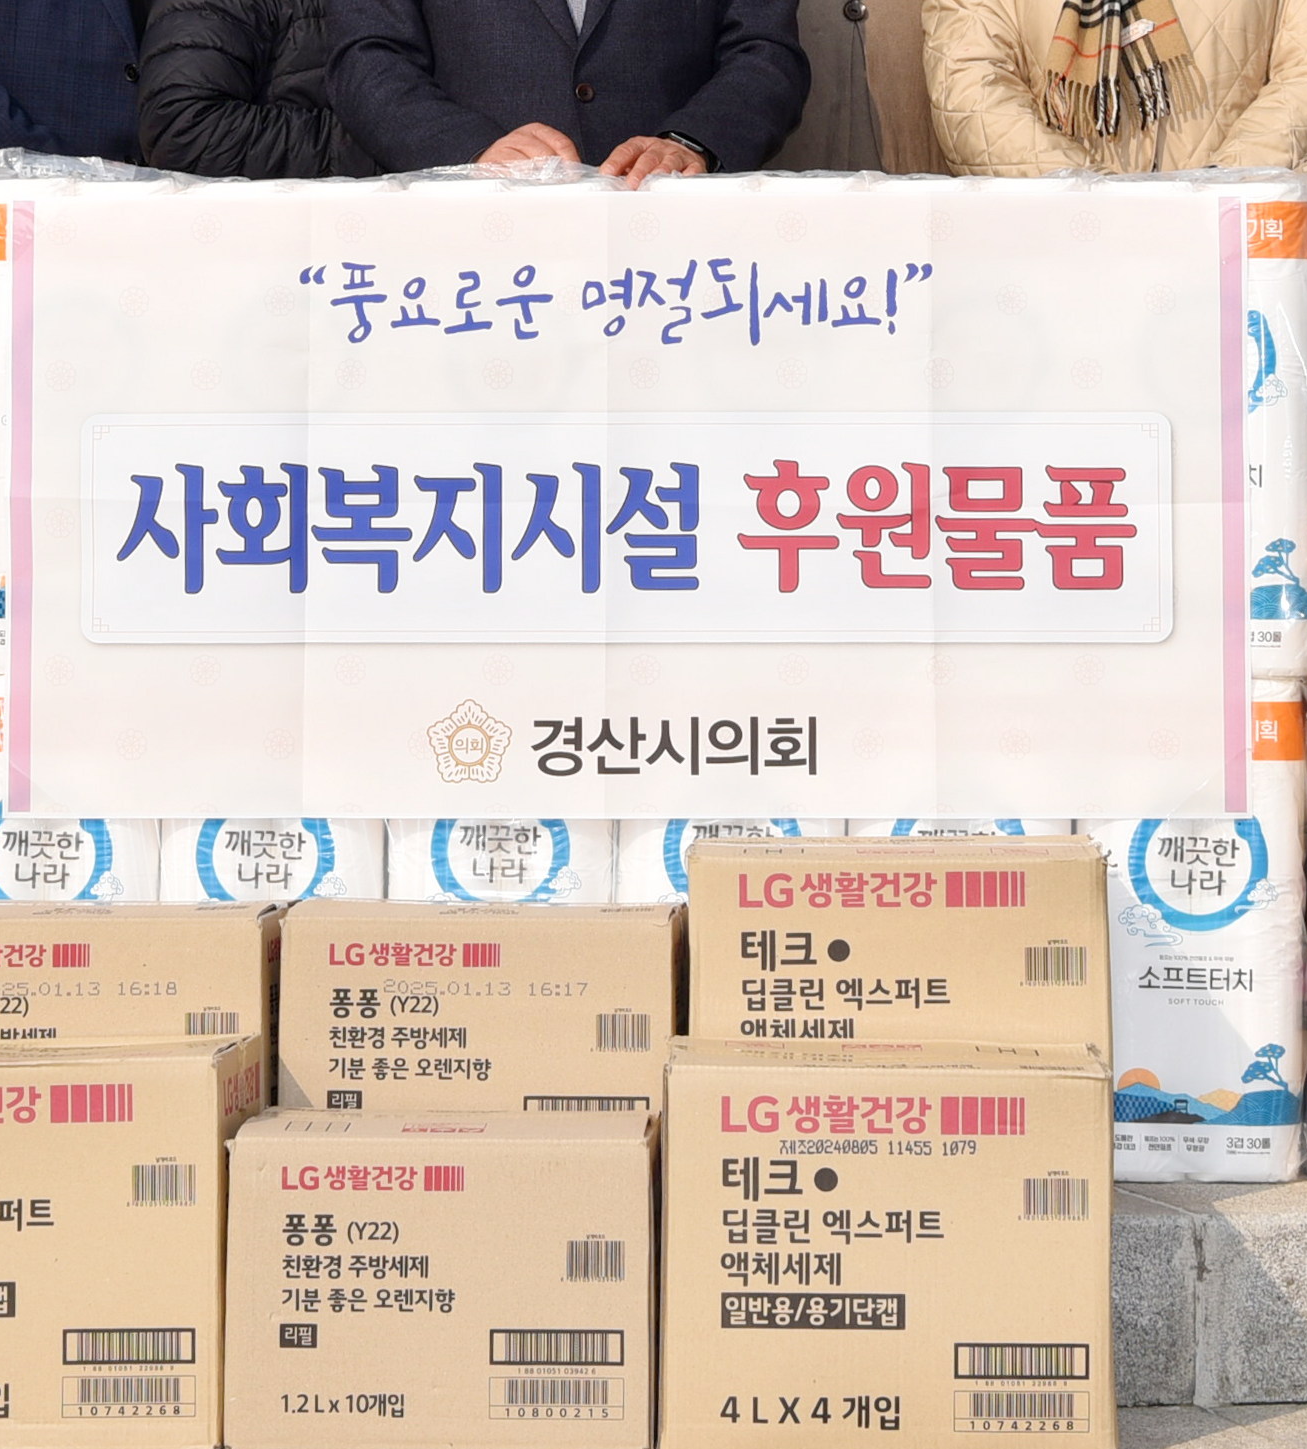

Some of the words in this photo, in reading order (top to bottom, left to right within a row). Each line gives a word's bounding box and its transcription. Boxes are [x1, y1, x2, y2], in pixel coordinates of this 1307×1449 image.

[116, 460, 701, 595] 사회복지시설
[736, 458, 1138, 595] 후원물품
[455, 737, 484, 753] 의회
[530, 716, 818, 777] 경산시의회
[2, 830, 83, 861] 깨끗한
[225, 829, 306, 861] 깨끗한
[1157, 836, 1240, 867] 깨끗한
[15, 863, 69, 890] 나라
[237, 862, 292, 890] 나라
[738, 873, 794, 908] LG
[800, 871, 937, 908] 생활건강
[1171, 870, 1226, 896] 나라
[329, 944, 364, 966] LG
[369, 942, 456, 967] 생활건강
[740, 931, 817, 971] 테크
[118, 981, 178, 996] 16:18
[384, 979, 511, 996] 2025.01.13
[528, 982, 587, 996] 16:17
[1138, 966, 1253, 992] 소프트터치
[329, 988, 381, 1018] 퐁퐁
[390, 995, 439, 1016] (Y22)
[741, 979, 825, 1011] 딥클린
[835, 978, 951, 1010] 엑스퍼트
[329, 1027, 386, 1049] 친환경
[391, 1027, 466, 1049] 주방세제
[329, 1058, 366, 1079] 기분
[371, 1059, 409, 1079] 좋은
[415, 1058, 491, 1080] 오렌지향
[330, 1092, 359, 1108] 리필
[721, 1096, 779, 1133] LG
[786, 1096, 932, 1135] 생활건강
[888, 1140, 932, 1156] 11455
[942, 1140, 977, 1156] 1079
[282, 1166, 320, 1190] LG
[324, 1166, 417, 1191] 생활건강
[722, 1158, 803, 1201] 테크
[282, 1214, 338, 1246] 퐁퐁
[347, 1221, 399, 1244] (Y22)
[722, 1210, 810, 1245] 딥클린
[822, 1209, 944, 1244] 엑스퍼트
[282, 1256, 342, 1279] 친환경
[348, 1255, 428, 1279] 주방세제
[721, 1253, 842, 1286] 액체세제
[281, 1289, 321, 1312] 기분
[327, 1289, 367, 1312] 좋은
[375, 1288, 455, 1313] 오렌지향
[284, 1326, 313, 1345] 리필
